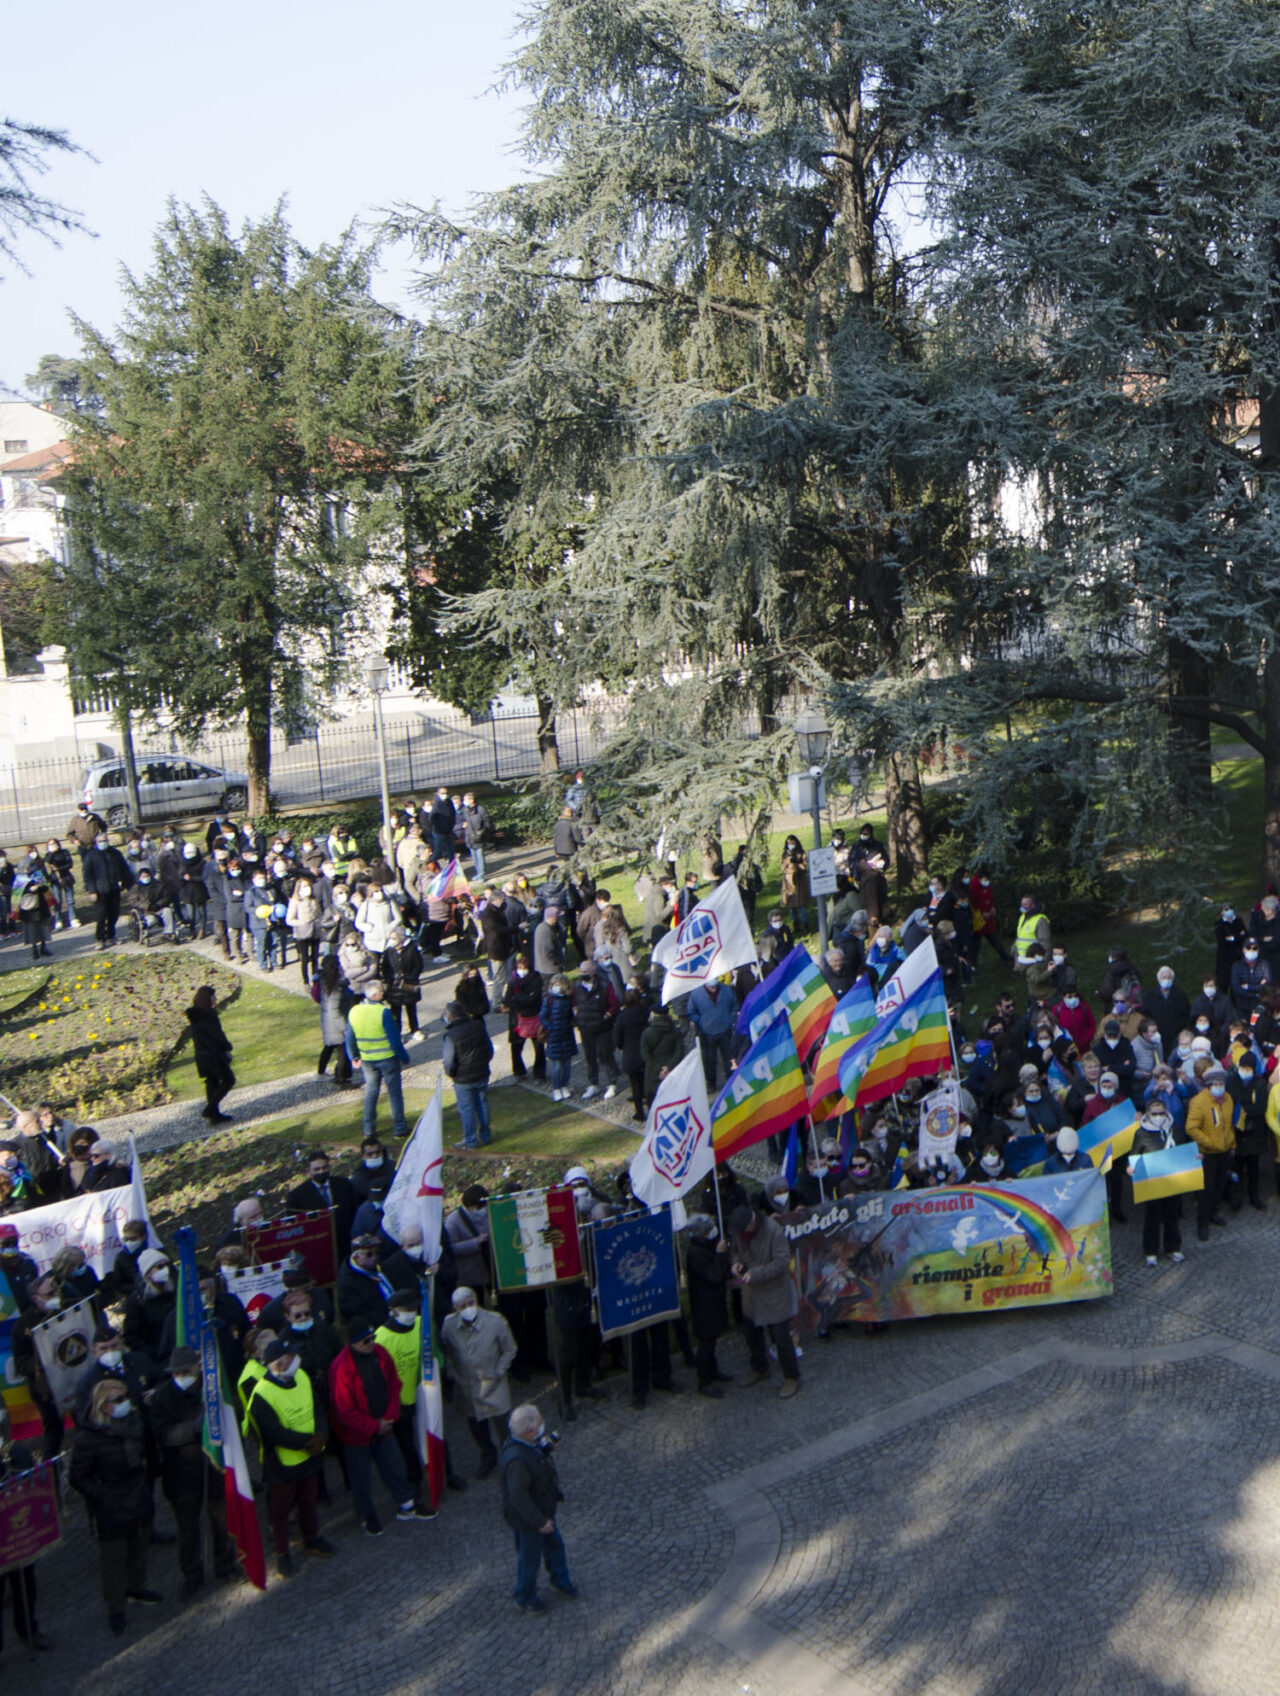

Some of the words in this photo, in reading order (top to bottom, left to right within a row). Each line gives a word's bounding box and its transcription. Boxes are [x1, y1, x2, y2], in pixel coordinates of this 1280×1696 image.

[856, 1198, 884, 1223] gli
[891, 1192, 975, 1217] arsenali
[912, 1261, 1004, 1286] riempite
[964, 1283, 972, 1301] i
[981, 1275, 1053, 1305] granai
